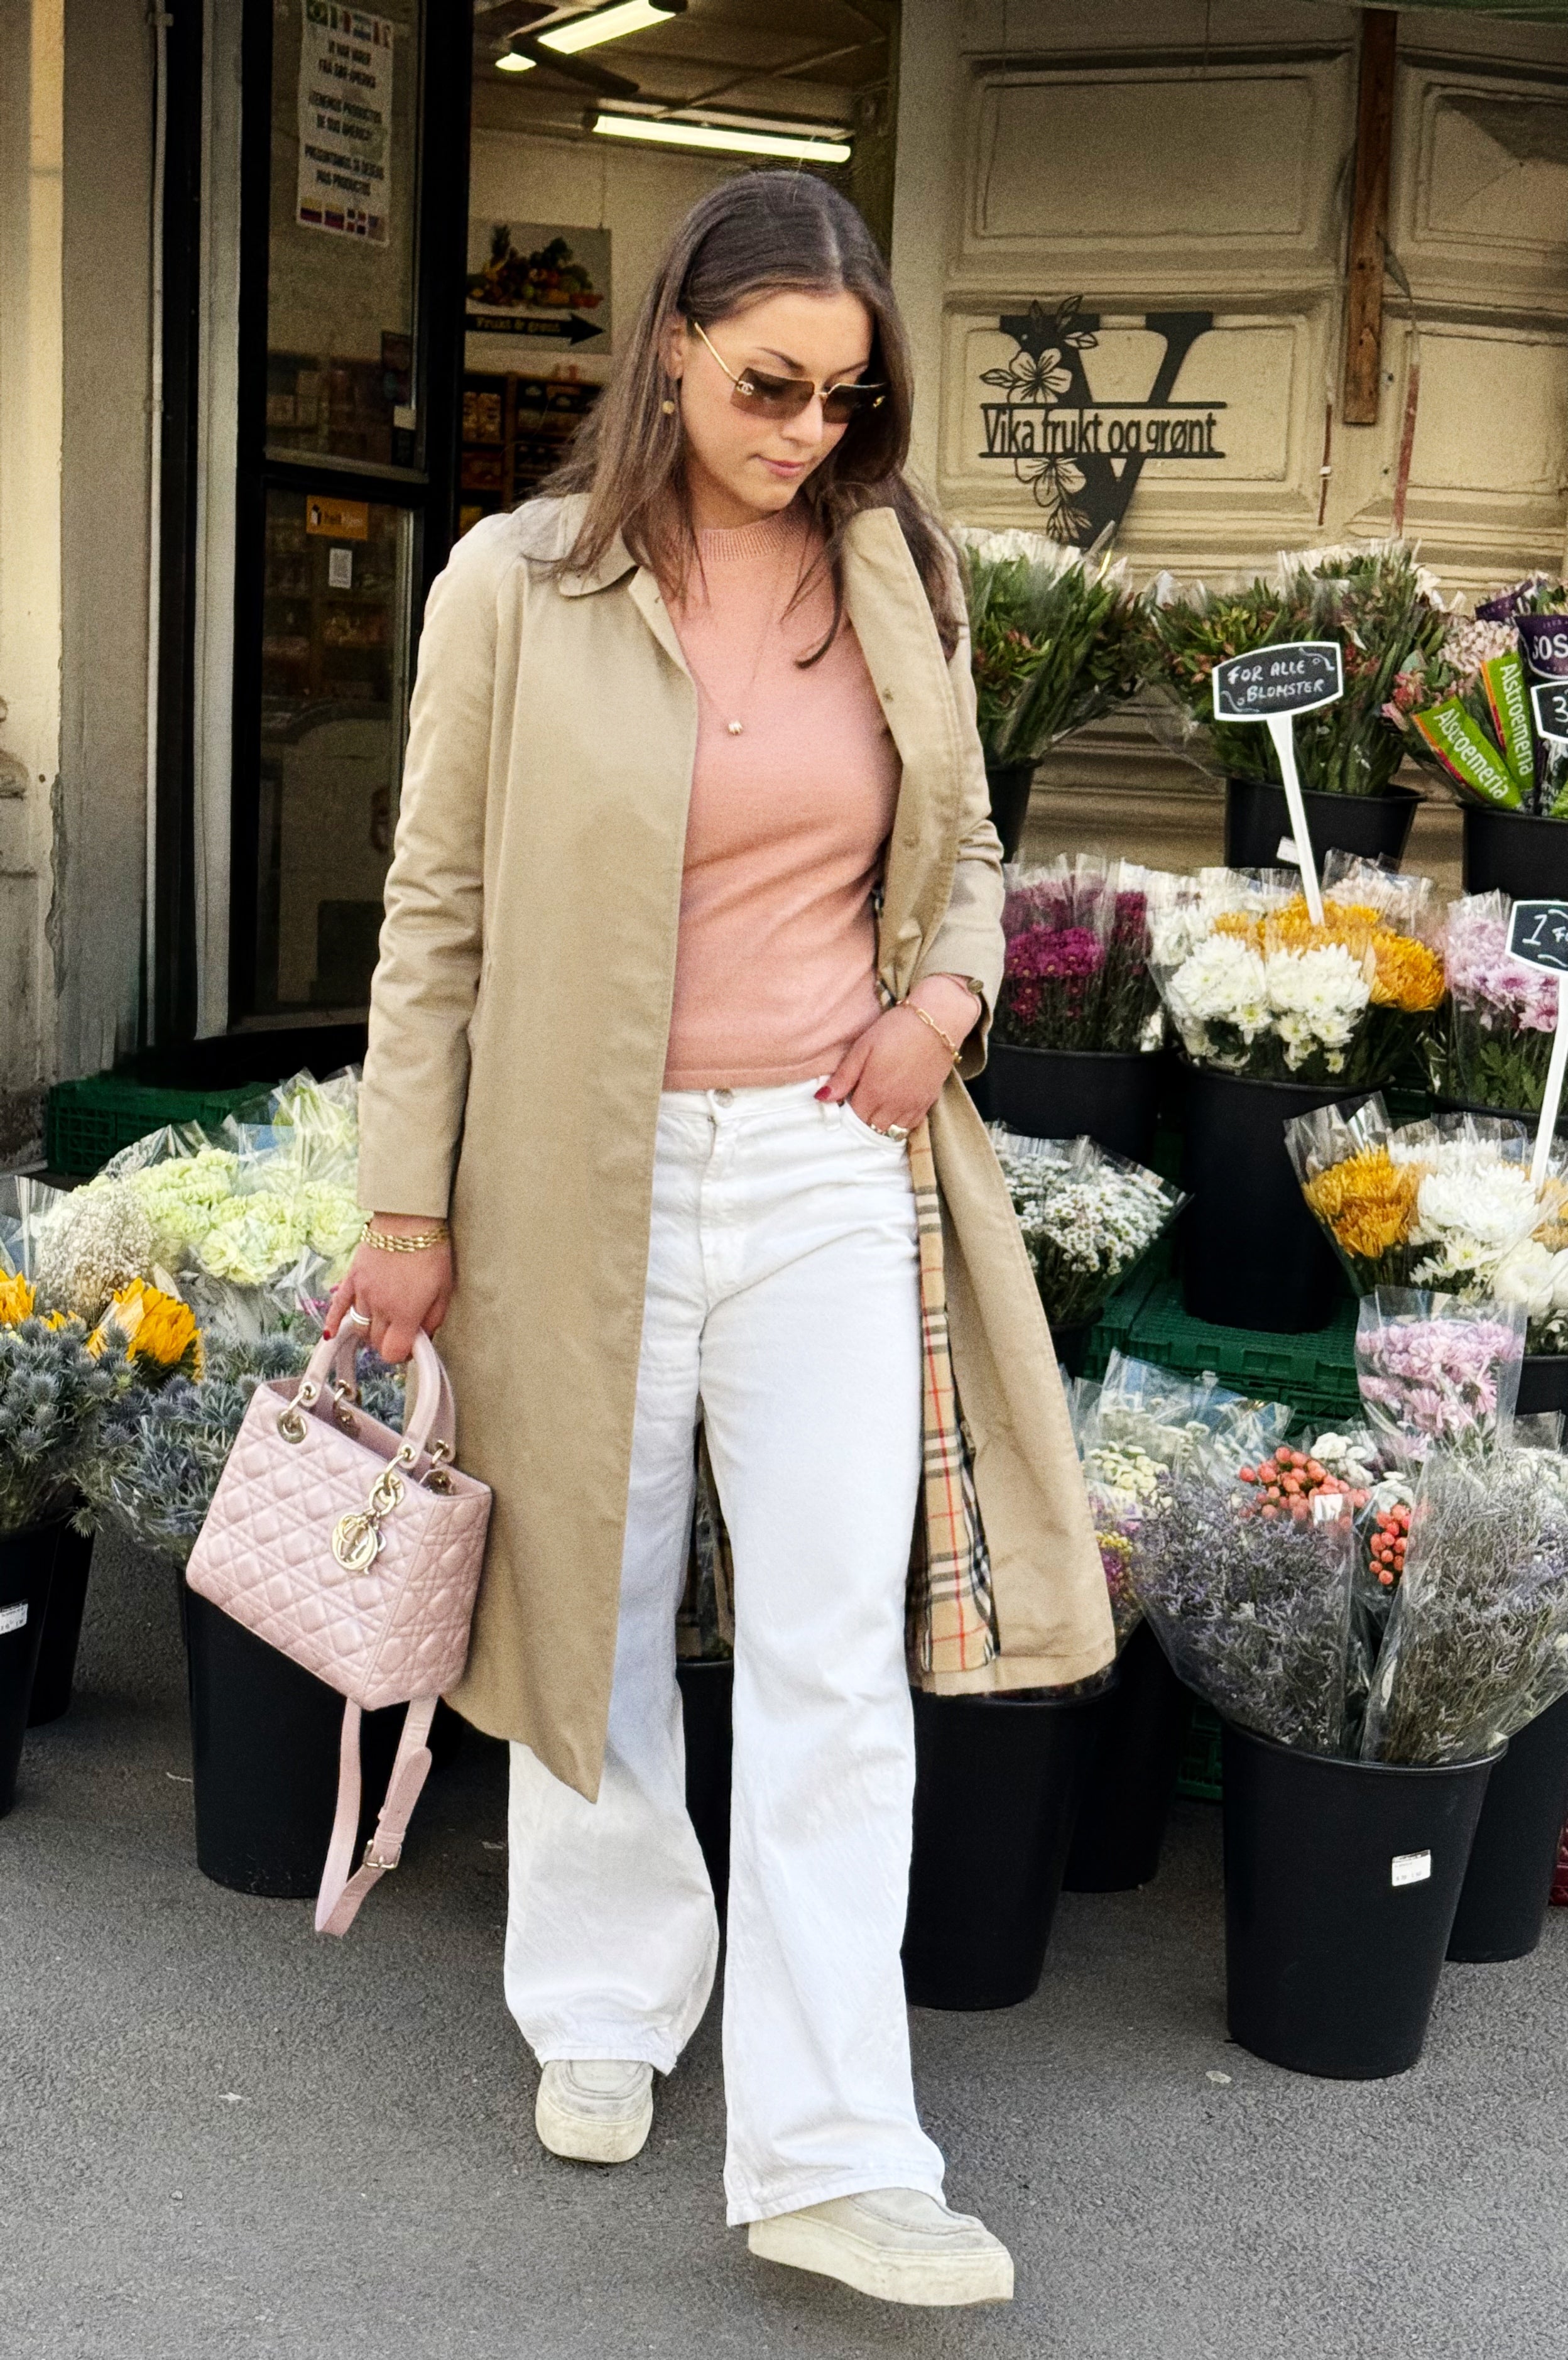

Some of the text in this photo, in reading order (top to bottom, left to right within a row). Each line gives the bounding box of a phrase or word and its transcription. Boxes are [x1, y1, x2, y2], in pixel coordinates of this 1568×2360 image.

[983, 408, 1216, 454] Vika frukt og grønt
[1246, 679, 1325, 702] BLOMSTER
[1270, 660, 1305, 677] ALLE
[1500, 662, 1534, 777] Alstroemeria
[1433, 707, 1509, 800] Alstroemeria
